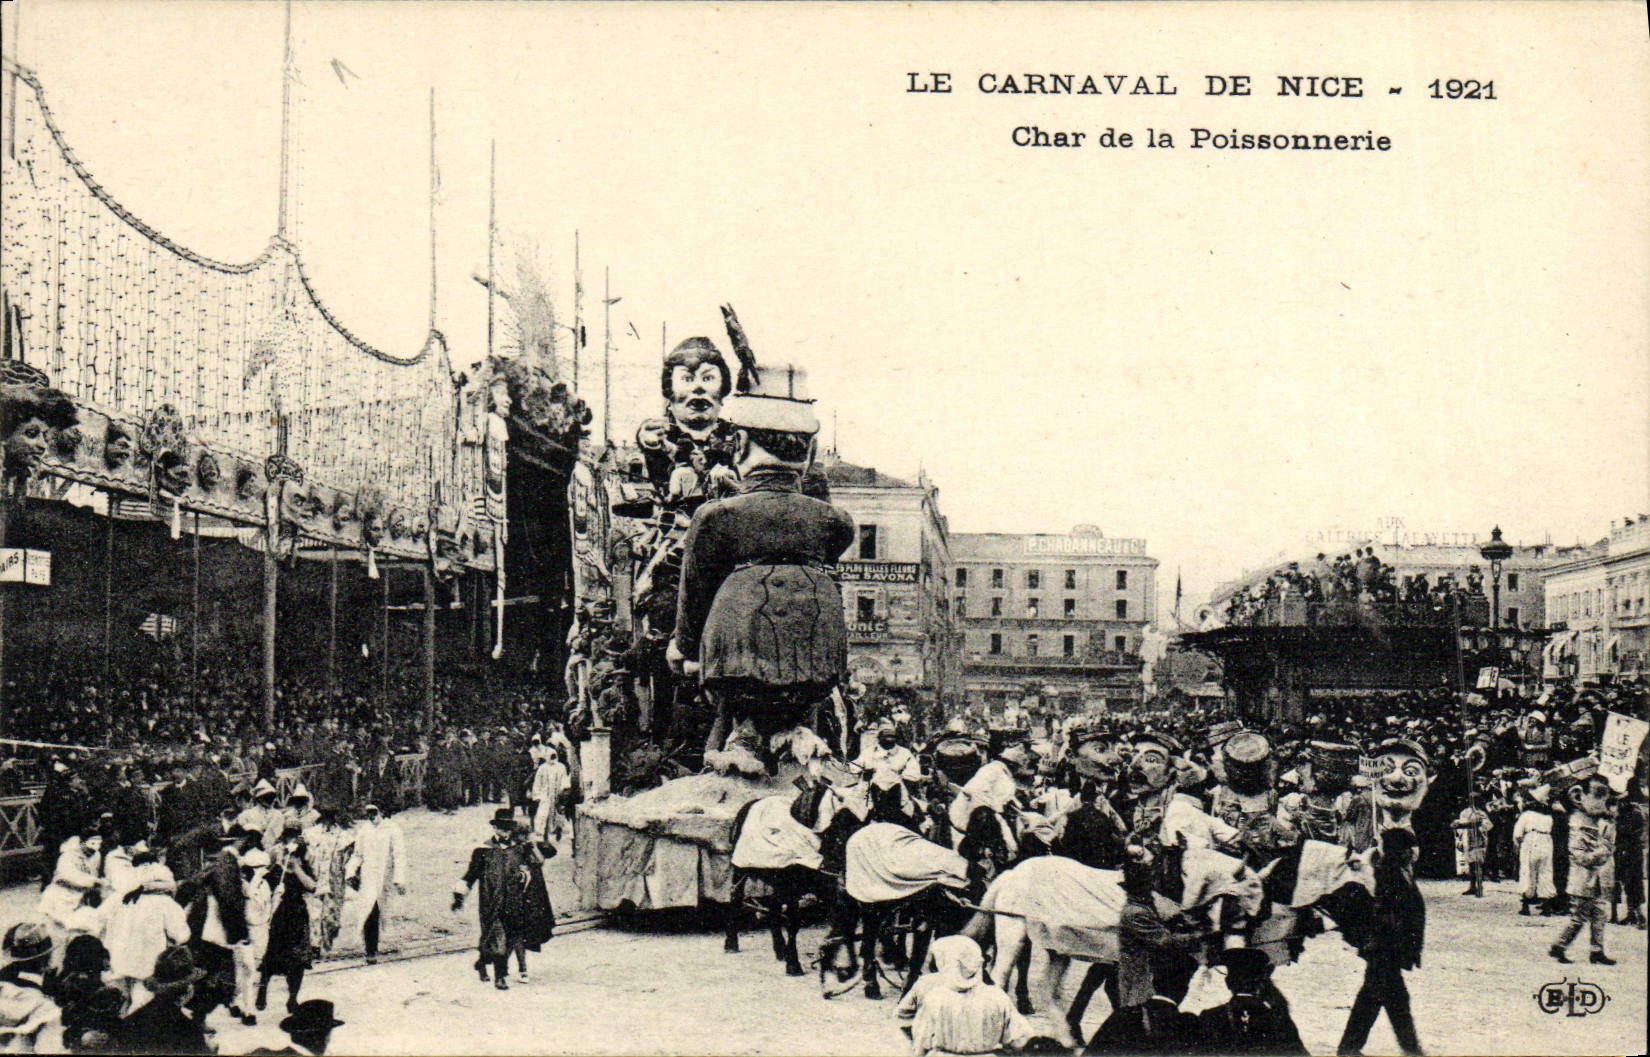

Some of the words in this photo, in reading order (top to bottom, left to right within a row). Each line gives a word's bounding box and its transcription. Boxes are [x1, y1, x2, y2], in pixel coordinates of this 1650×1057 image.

[864, 564, 889, 573] BELLES
[890, 564, 916, 574] FLEURS
[863, 572, 915, 581] SAVONA
